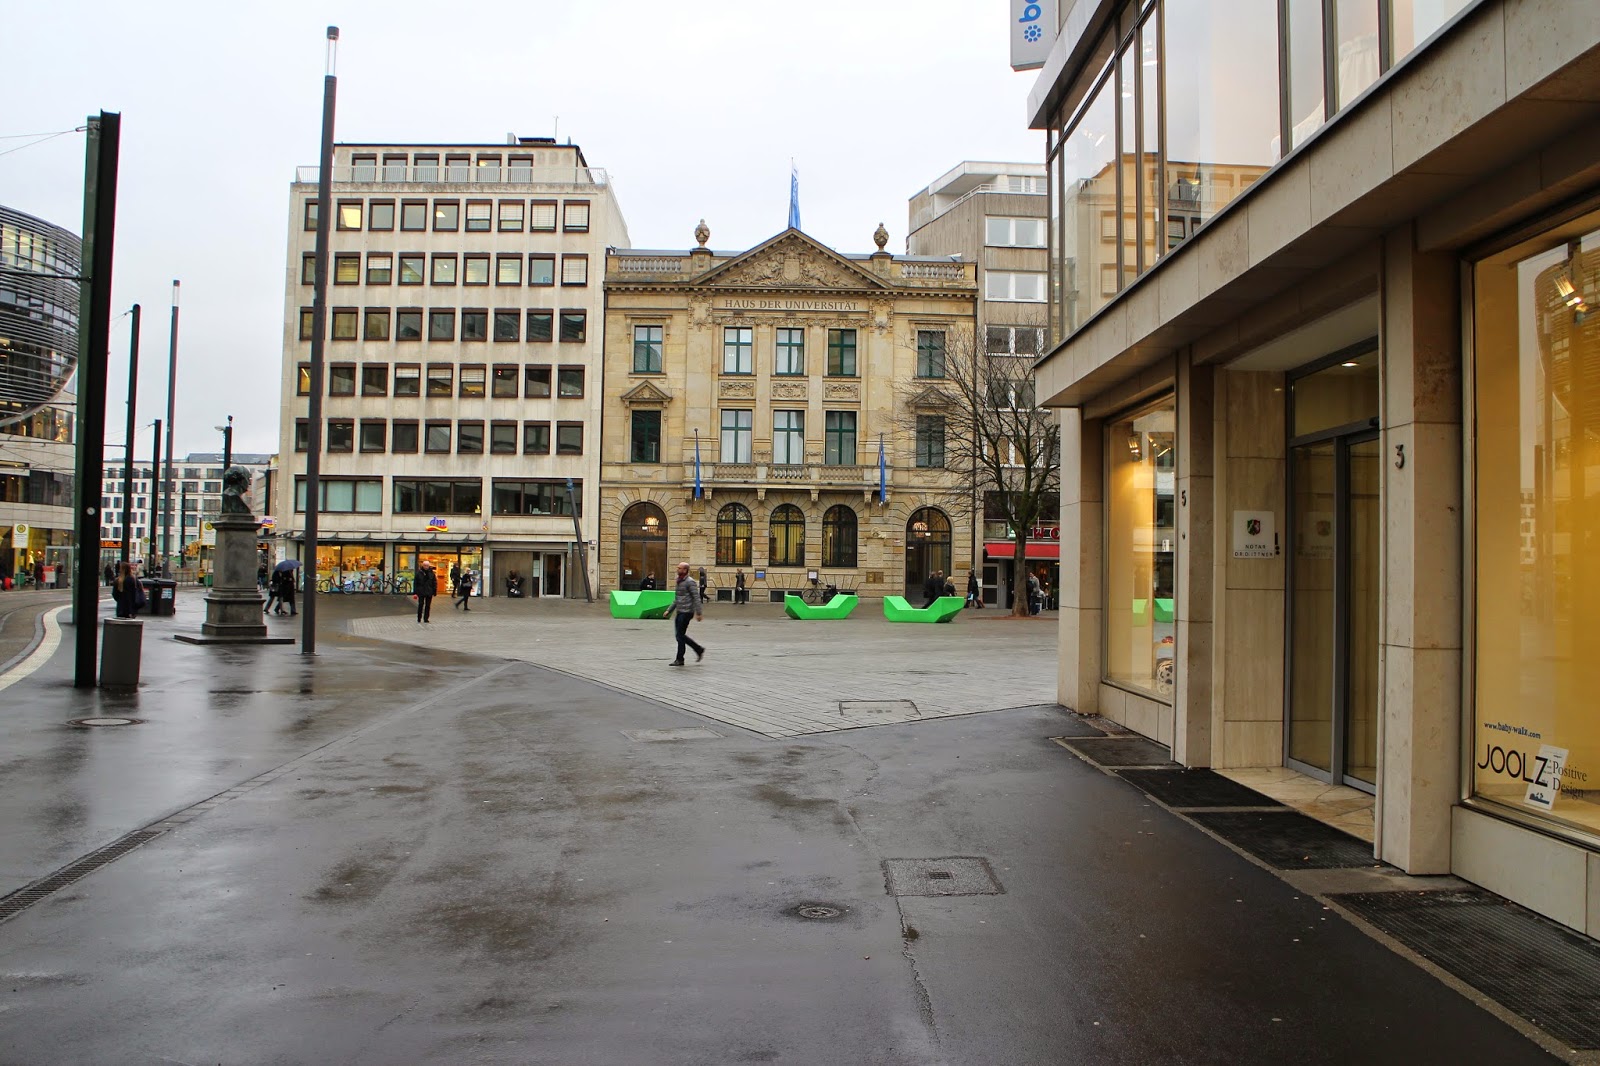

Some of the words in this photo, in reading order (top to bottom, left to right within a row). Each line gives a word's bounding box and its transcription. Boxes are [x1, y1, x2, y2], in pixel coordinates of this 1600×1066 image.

[725, 300, 756, 309] HAUS
[759, 300, 781, 309] DER
[785, 300, 858, 310] UNIVERSITÄT
[1394, 444, 1405, 469] 3
[1181, 490, 1187, 507] 5
[429, 516, 446, 526] dm
[1483, 722, 1541, 739] www.baby-walz.com
[1477, 744, 1548, 787] JOOLZ
[1552, 760, 1587, 782] Positive
[1552, 777, 1584, 800] Design
